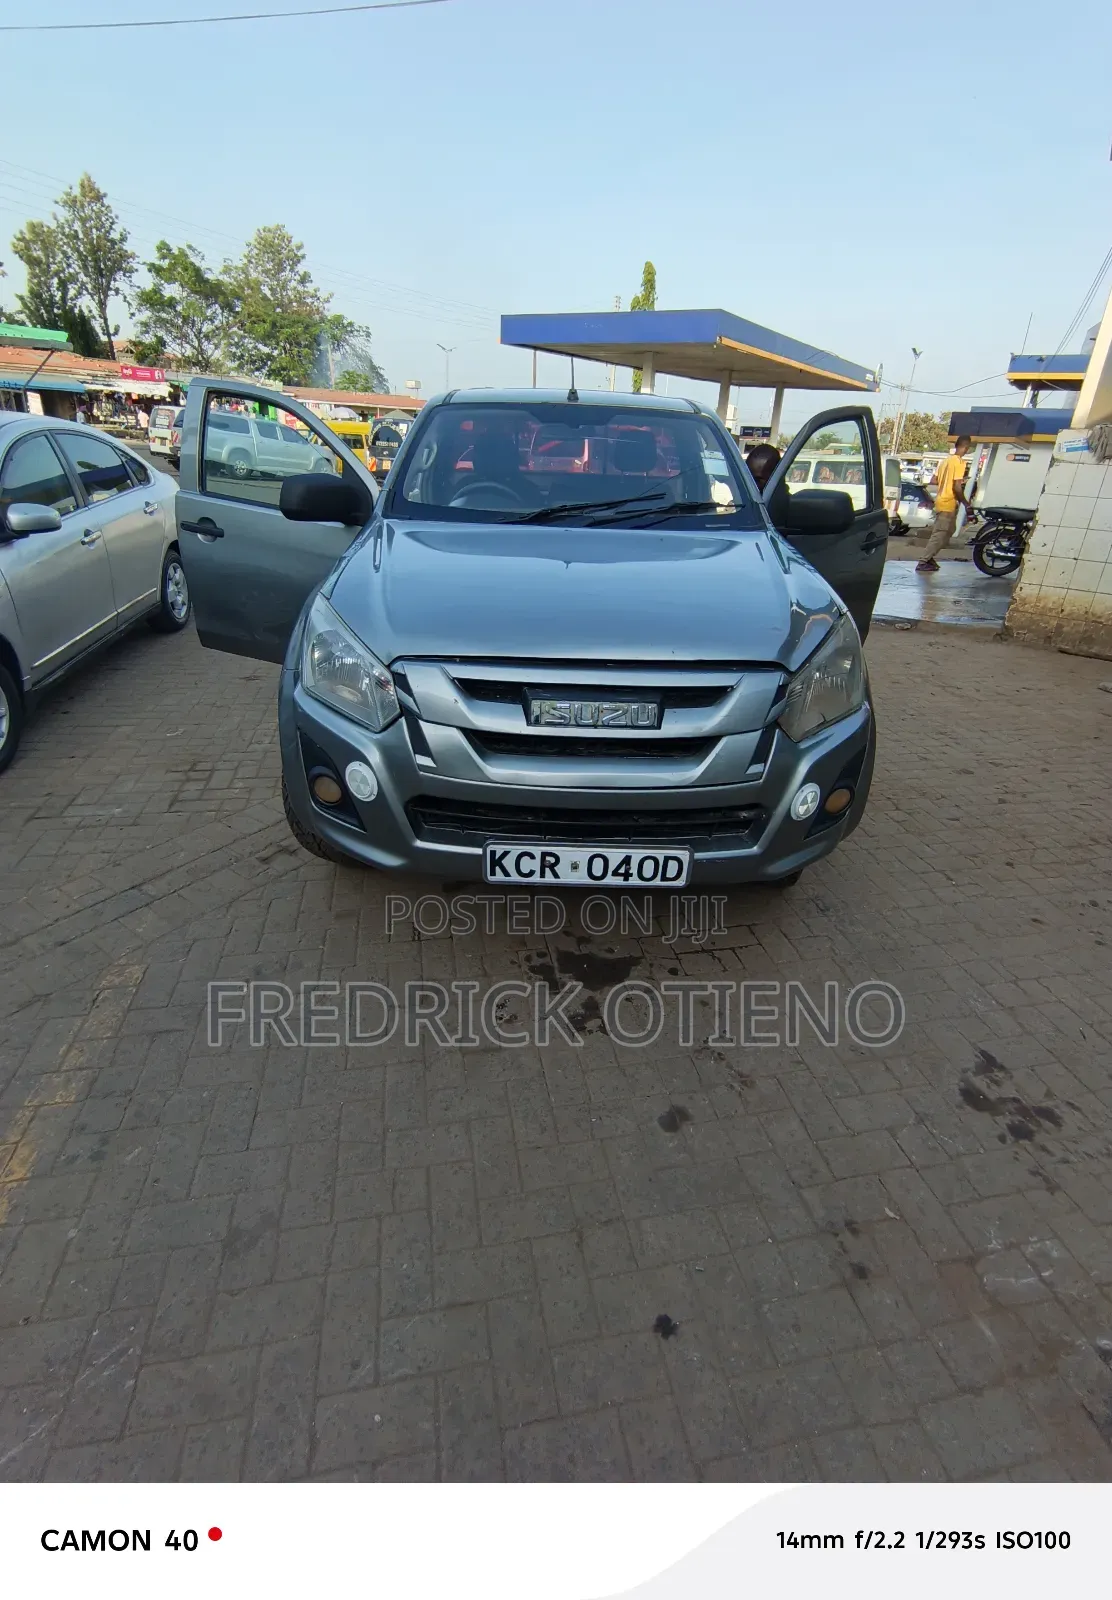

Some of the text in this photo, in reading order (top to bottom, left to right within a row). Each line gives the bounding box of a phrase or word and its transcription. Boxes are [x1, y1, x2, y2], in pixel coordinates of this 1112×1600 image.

[531, 700, 658, 727] ISUZU
[489, 849, 684, 883] KCR 040D
